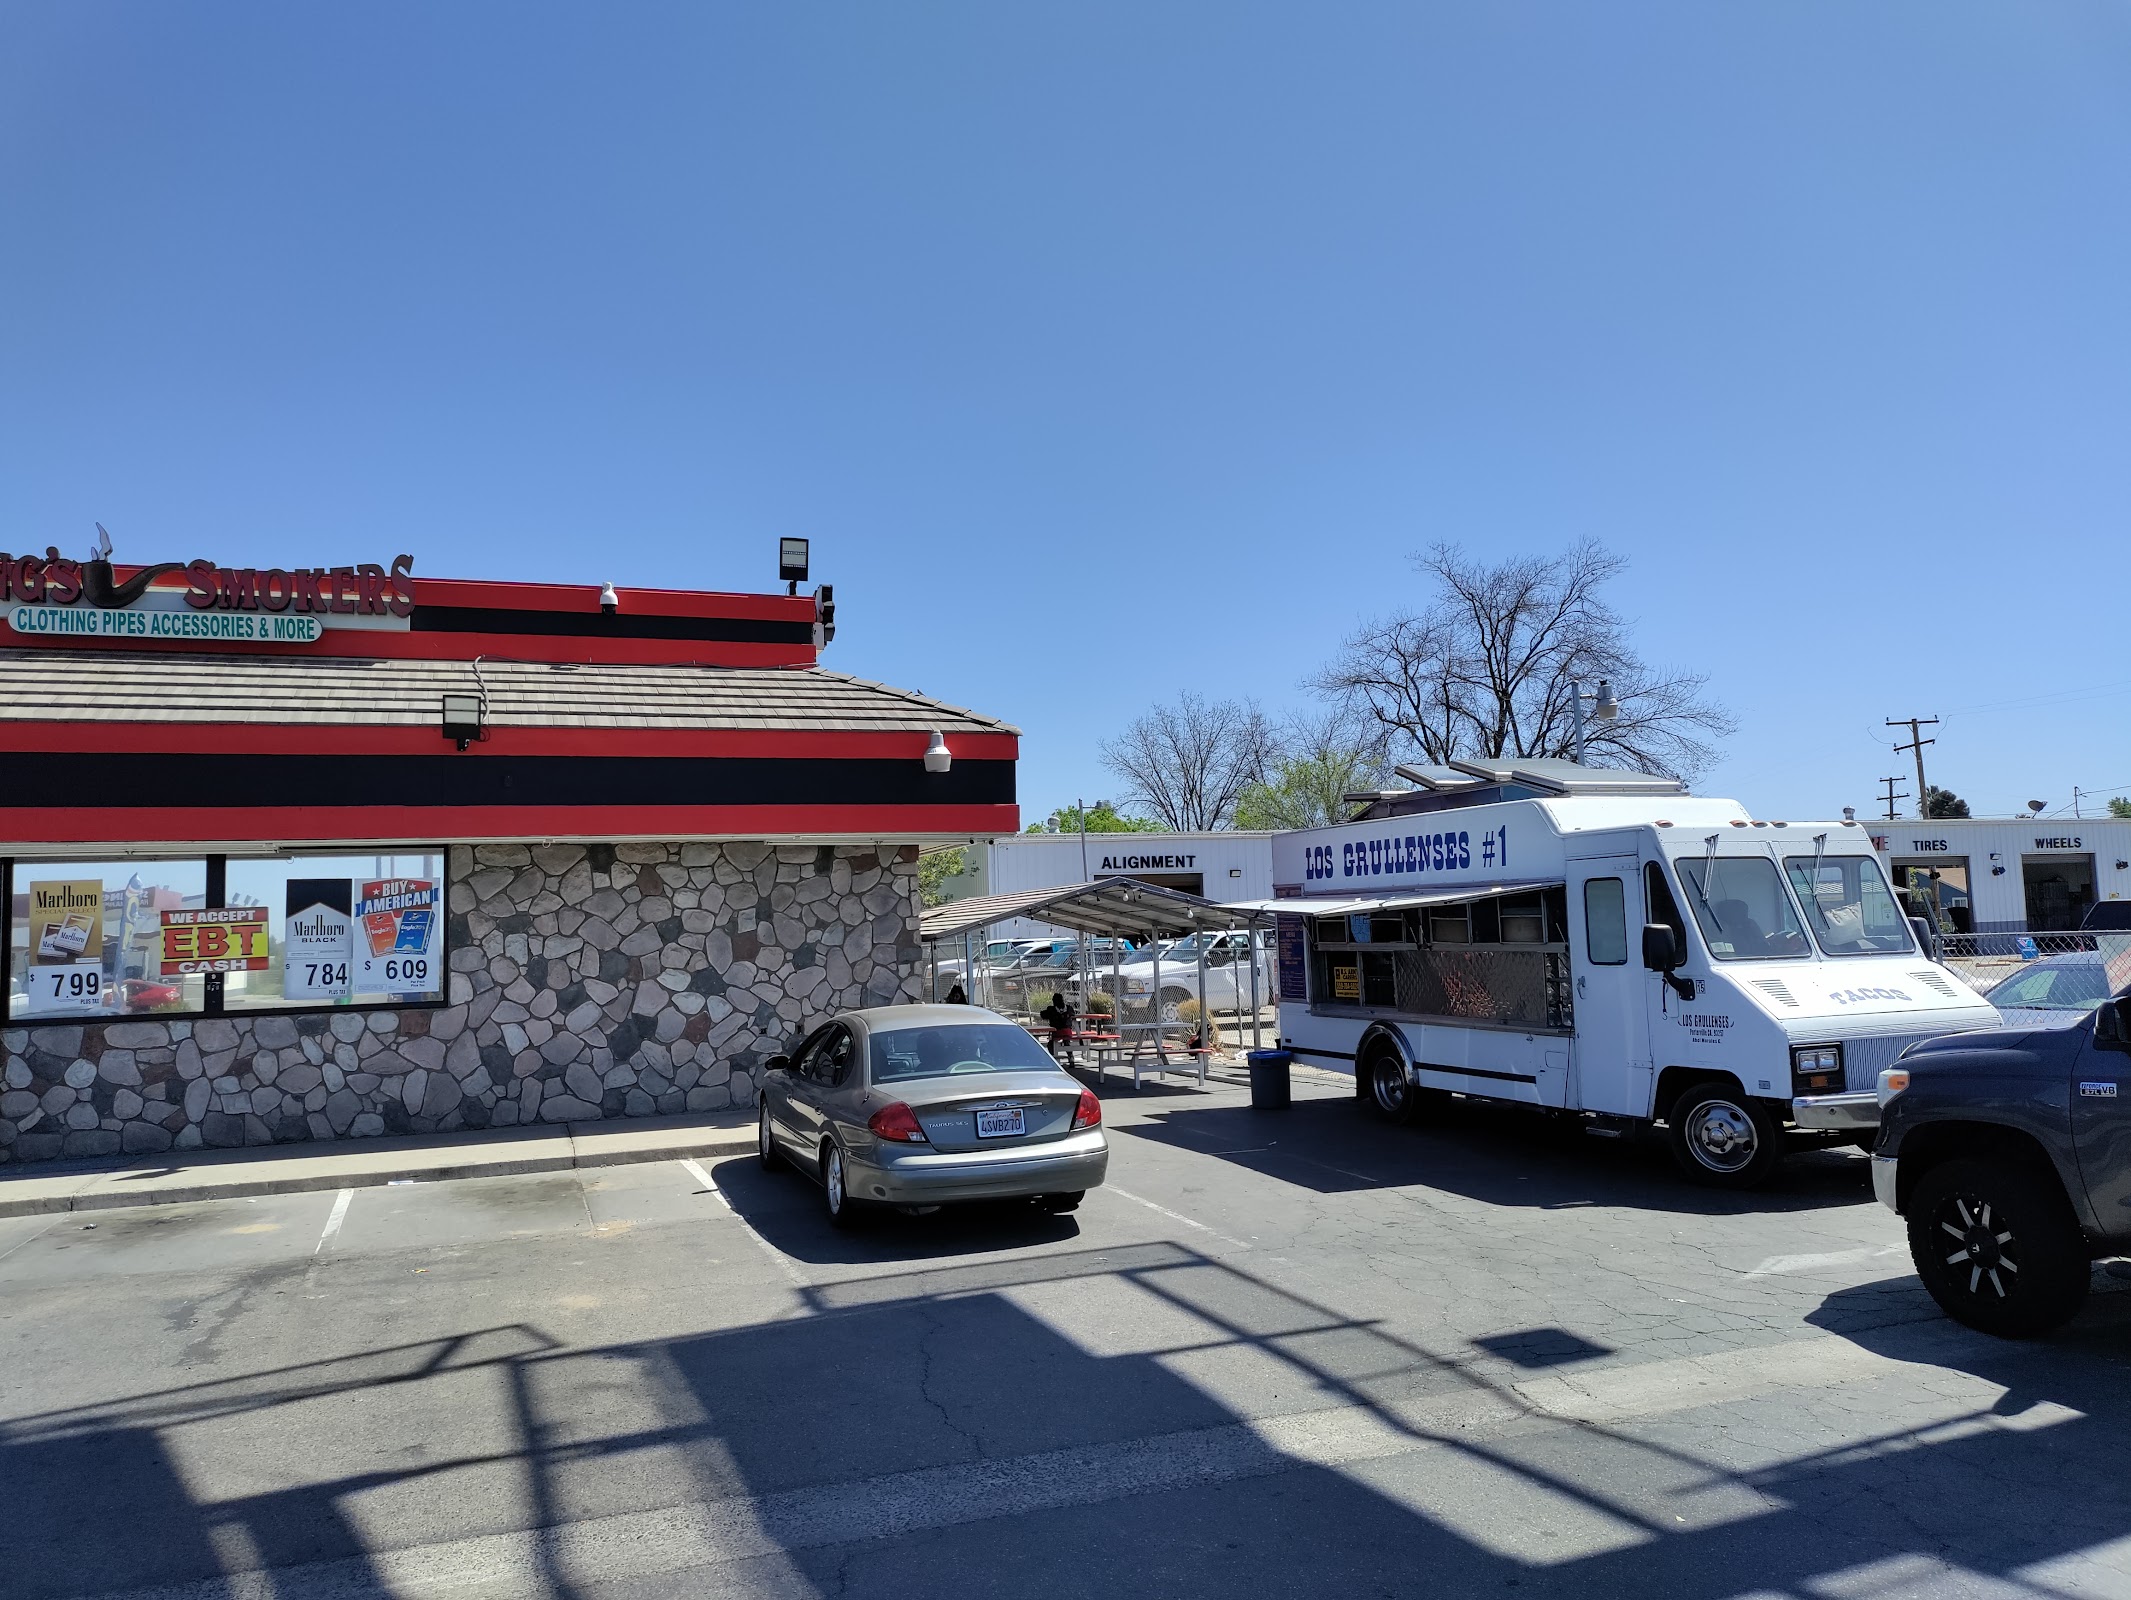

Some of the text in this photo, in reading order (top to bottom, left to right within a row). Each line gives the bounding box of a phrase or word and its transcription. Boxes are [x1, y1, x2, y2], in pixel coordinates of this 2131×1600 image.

[183, 554, 415, 619] SMOKERS
[17, 608, 315, 640] CLOTHING PIPES ACCESSORIES & MORE
[1913, 839, 1948, 852] TIRES
[2035, 837, 2082, 849] WHEELS
[1305, 824, 1507, 880] LOS GRULLENSES #1
[1101, 855, 1196, 869] ALIGNMENT
[36, 885, 97, 908] Marlboro
[382, 880, 408, 897] BUY
[364, 889, 431, 914] AMERICAN
[169, 910, 256, 924] WE ACCEPT
[293, 914, 344, 937] Marlboro
[60, 931, 85, 943] Marlboro
[163, 924, 263, 959] EBT
[178, 959, 247, 973] CASH
[364, 959, 428, 982] $ 6.09
[305, 962, 347, 988] 7.84
[30, 972, 99, 998] $ 7.99
[1697, 983, 1705, 993] 15
[1829, 988, 1912, 1004] TACOS
[1682, 1014, 1729, 1028] LOS GRULLENSES
[981, 1119, 1020, 1132] 4SVB270
